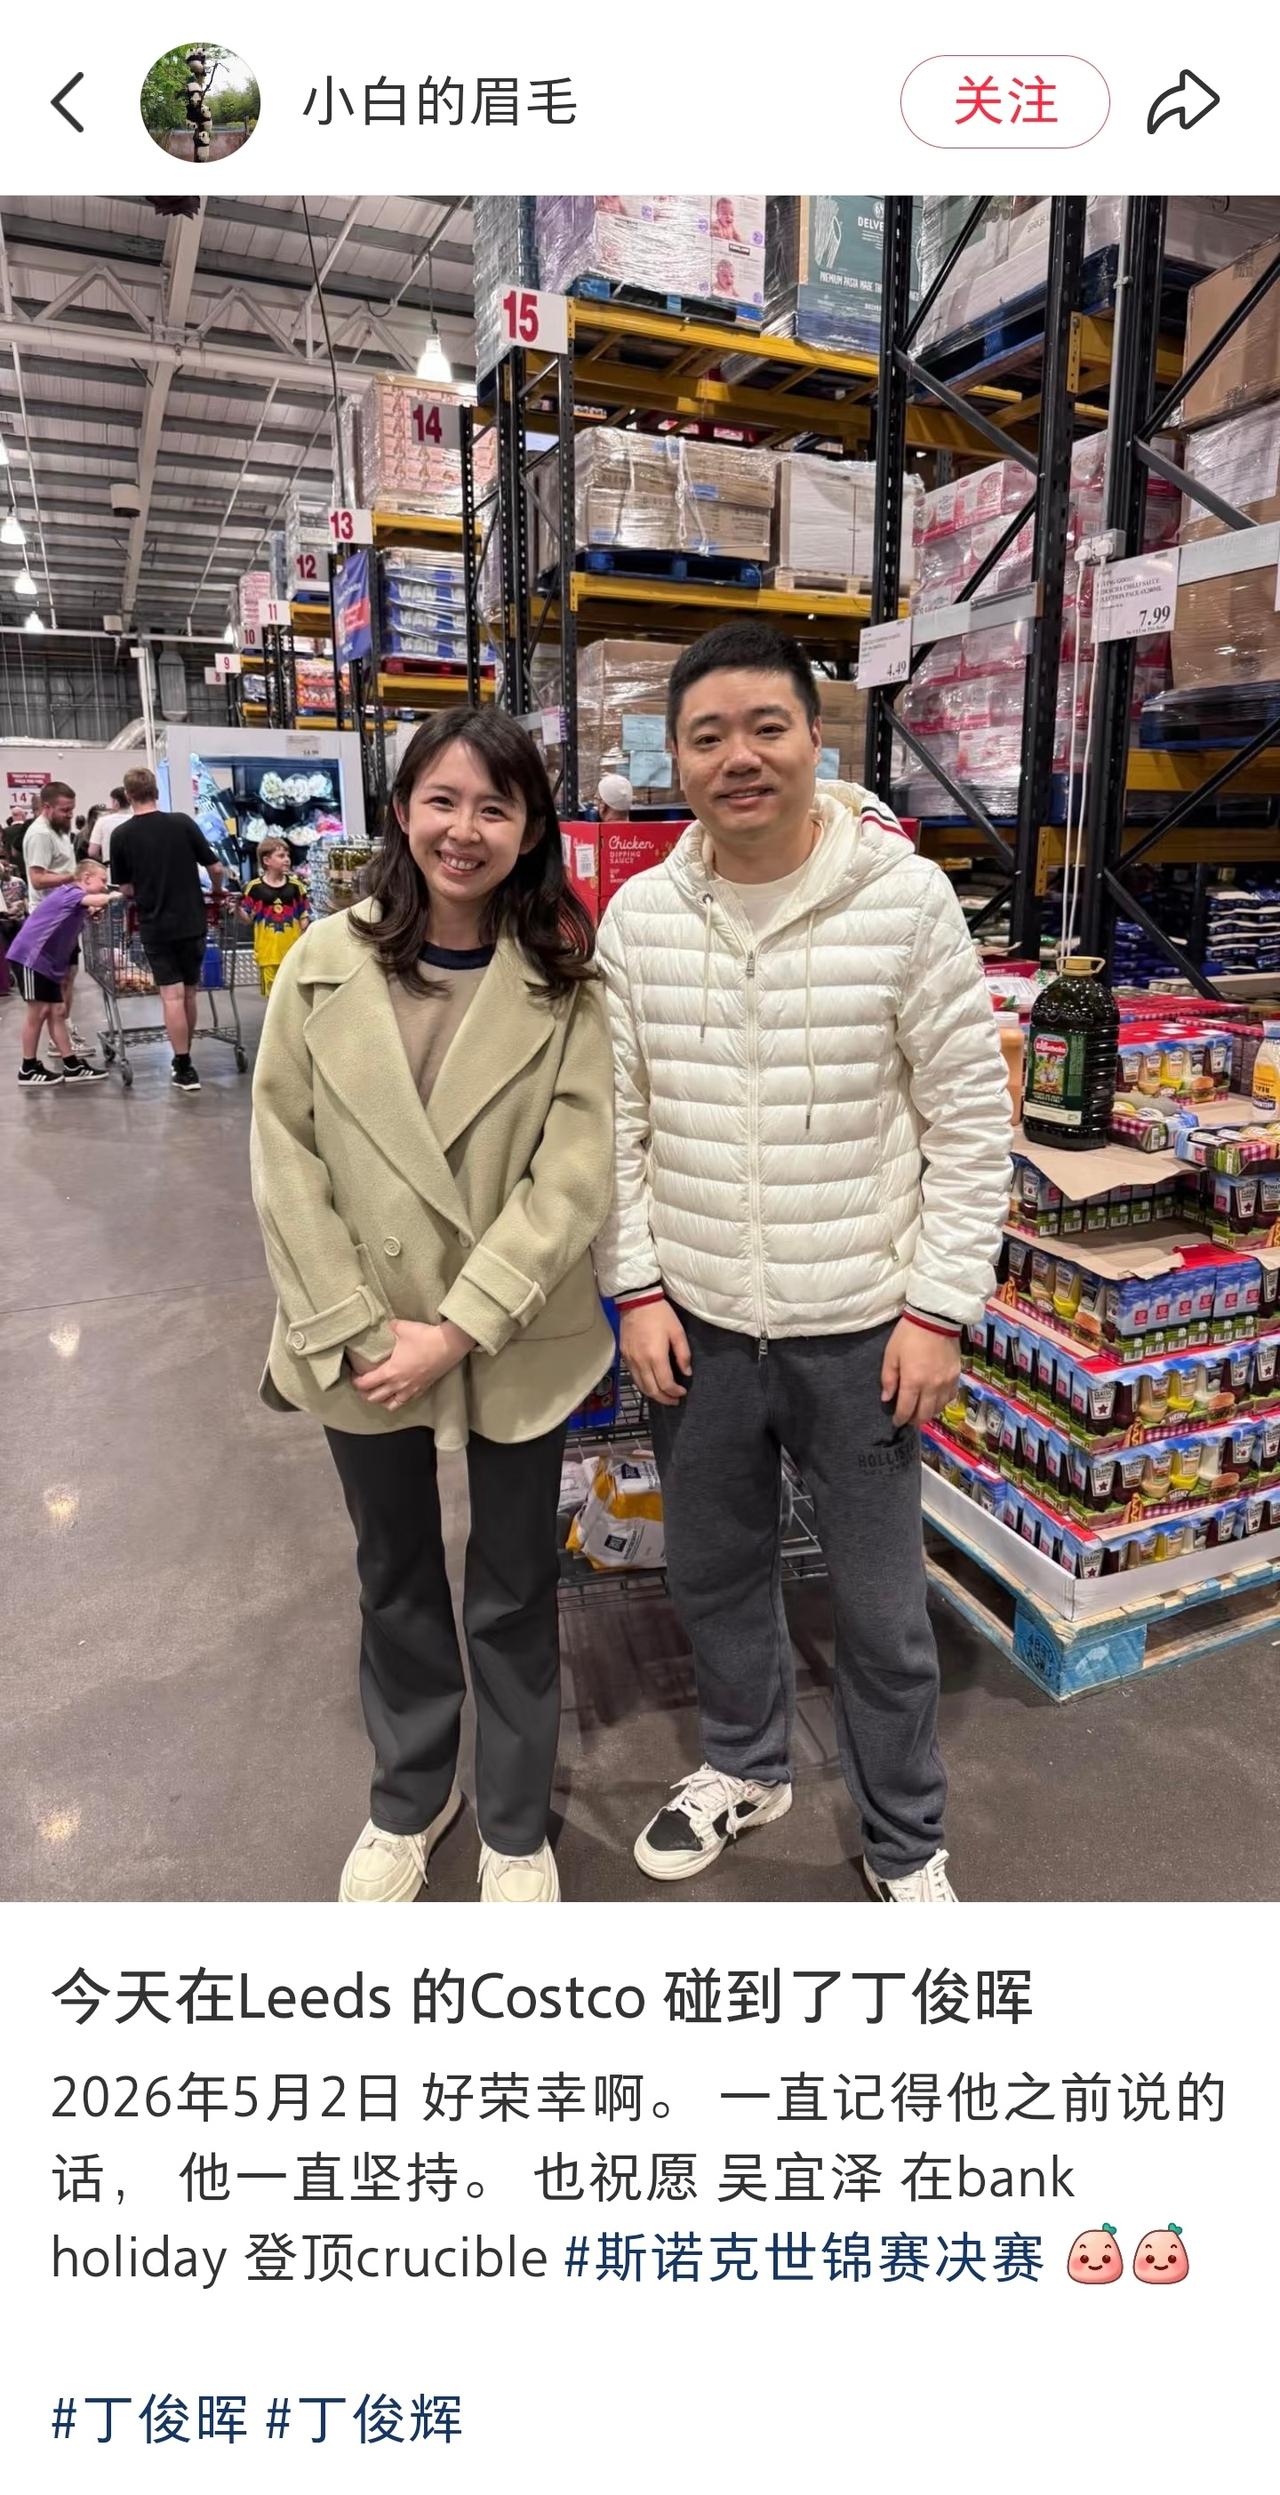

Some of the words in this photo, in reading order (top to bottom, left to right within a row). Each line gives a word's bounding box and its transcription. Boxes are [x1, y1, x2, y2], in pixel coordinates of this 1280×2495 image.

[504, 290, 539, 343] 15
[413, 404, 442, 444] 14
[330, 511, 353, 540] 13
[297, 554, 317, 579] 12
[269, 603, 278, 621] 11
[1139, 605, 1171, 627] 7.99
[244, 629, 256, 645] 10
[224, 656, 231, 670] 9
[886, 660, 907, 678] 4.49
[609, 835, 654, 850] Chicken
[609, 850, 641, 858] DIPPING
